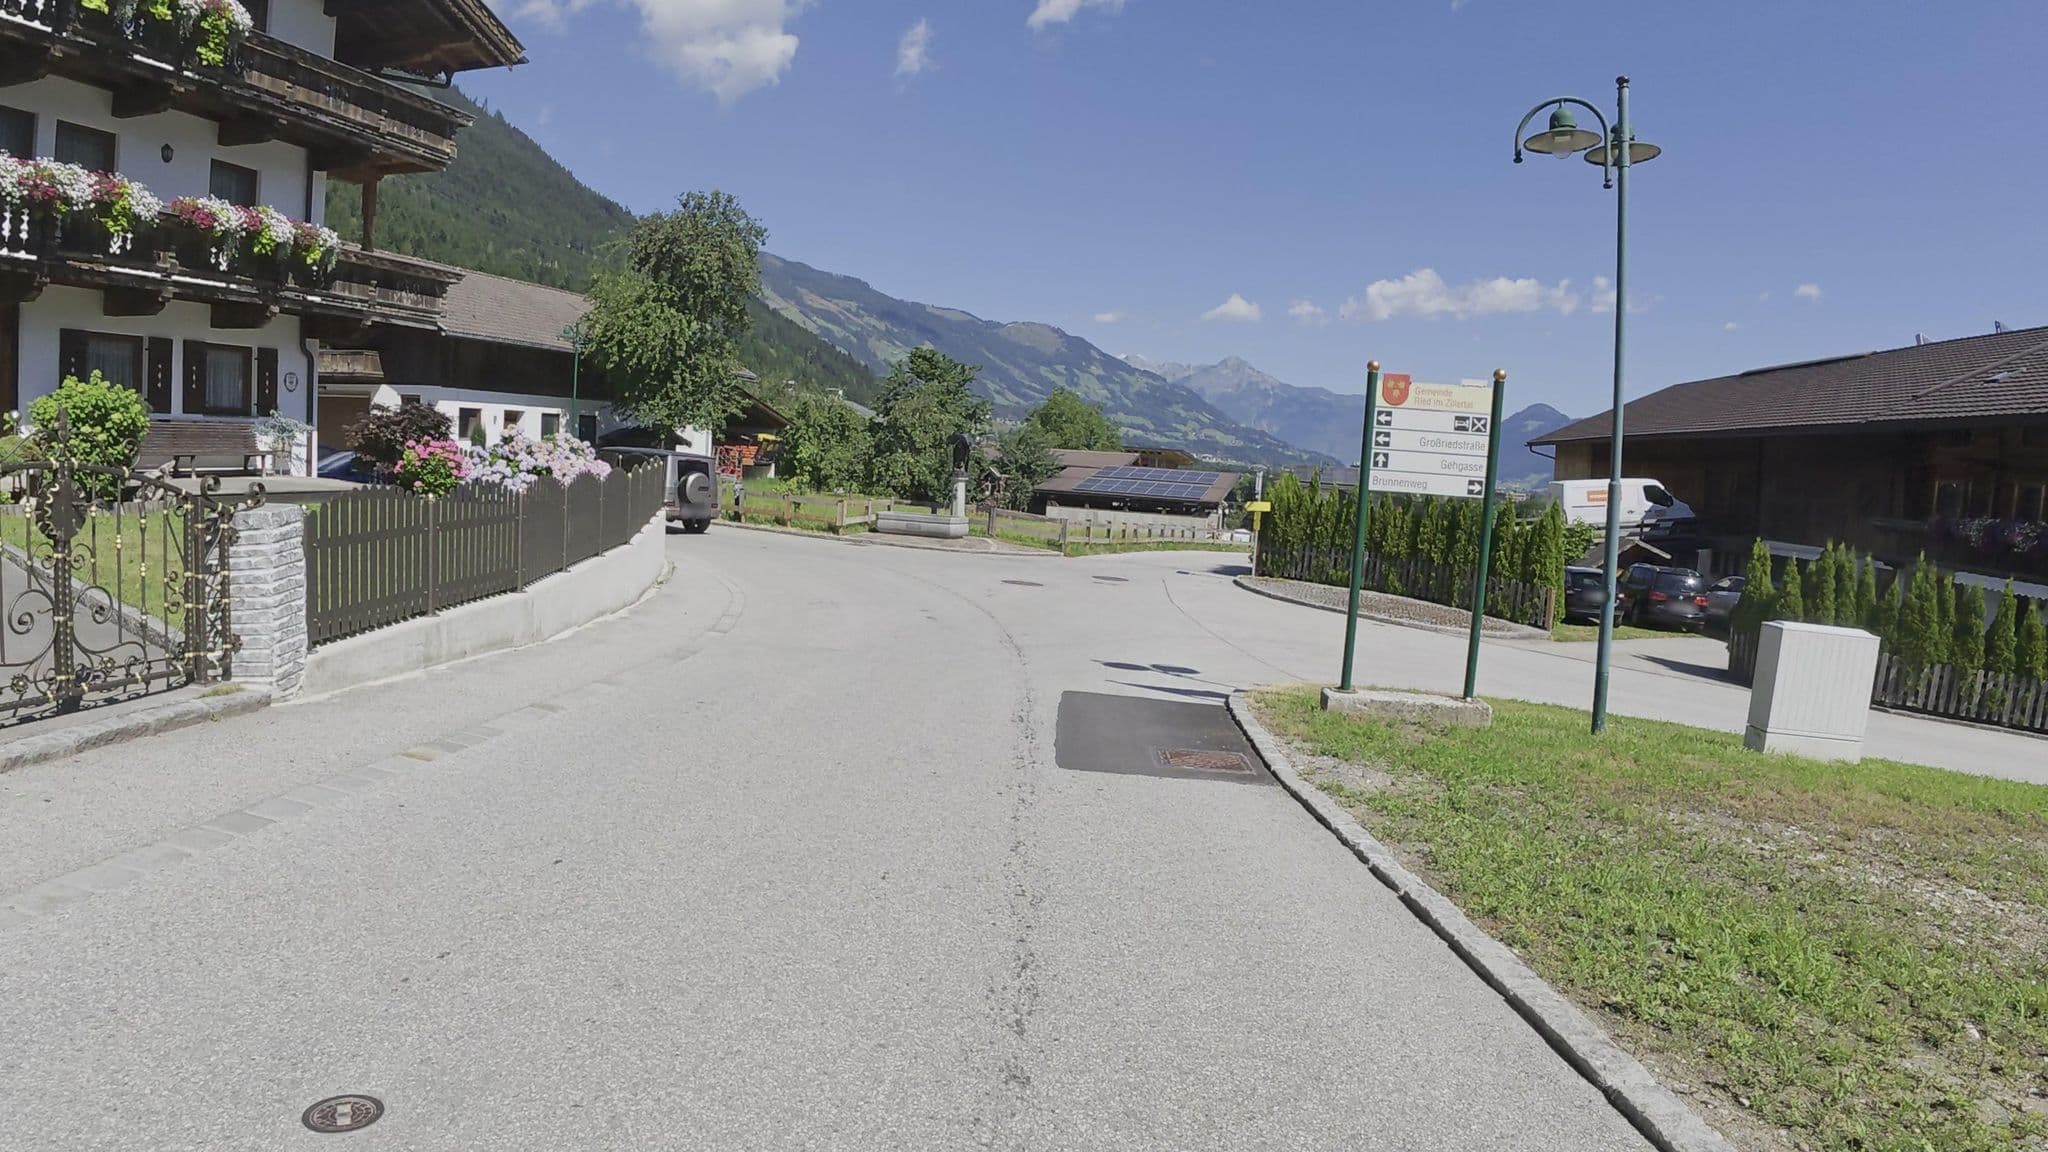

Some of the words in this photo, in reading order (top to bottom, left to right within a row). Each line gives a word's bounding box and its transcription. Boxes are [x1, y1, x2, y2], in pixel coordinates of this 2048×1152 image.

[1419, 437, 1486, 451] Großriedstraße
[1440, 459, 1484, 473] Gehgasse
[1372, 475, 1428, 490] Brunnenweg
